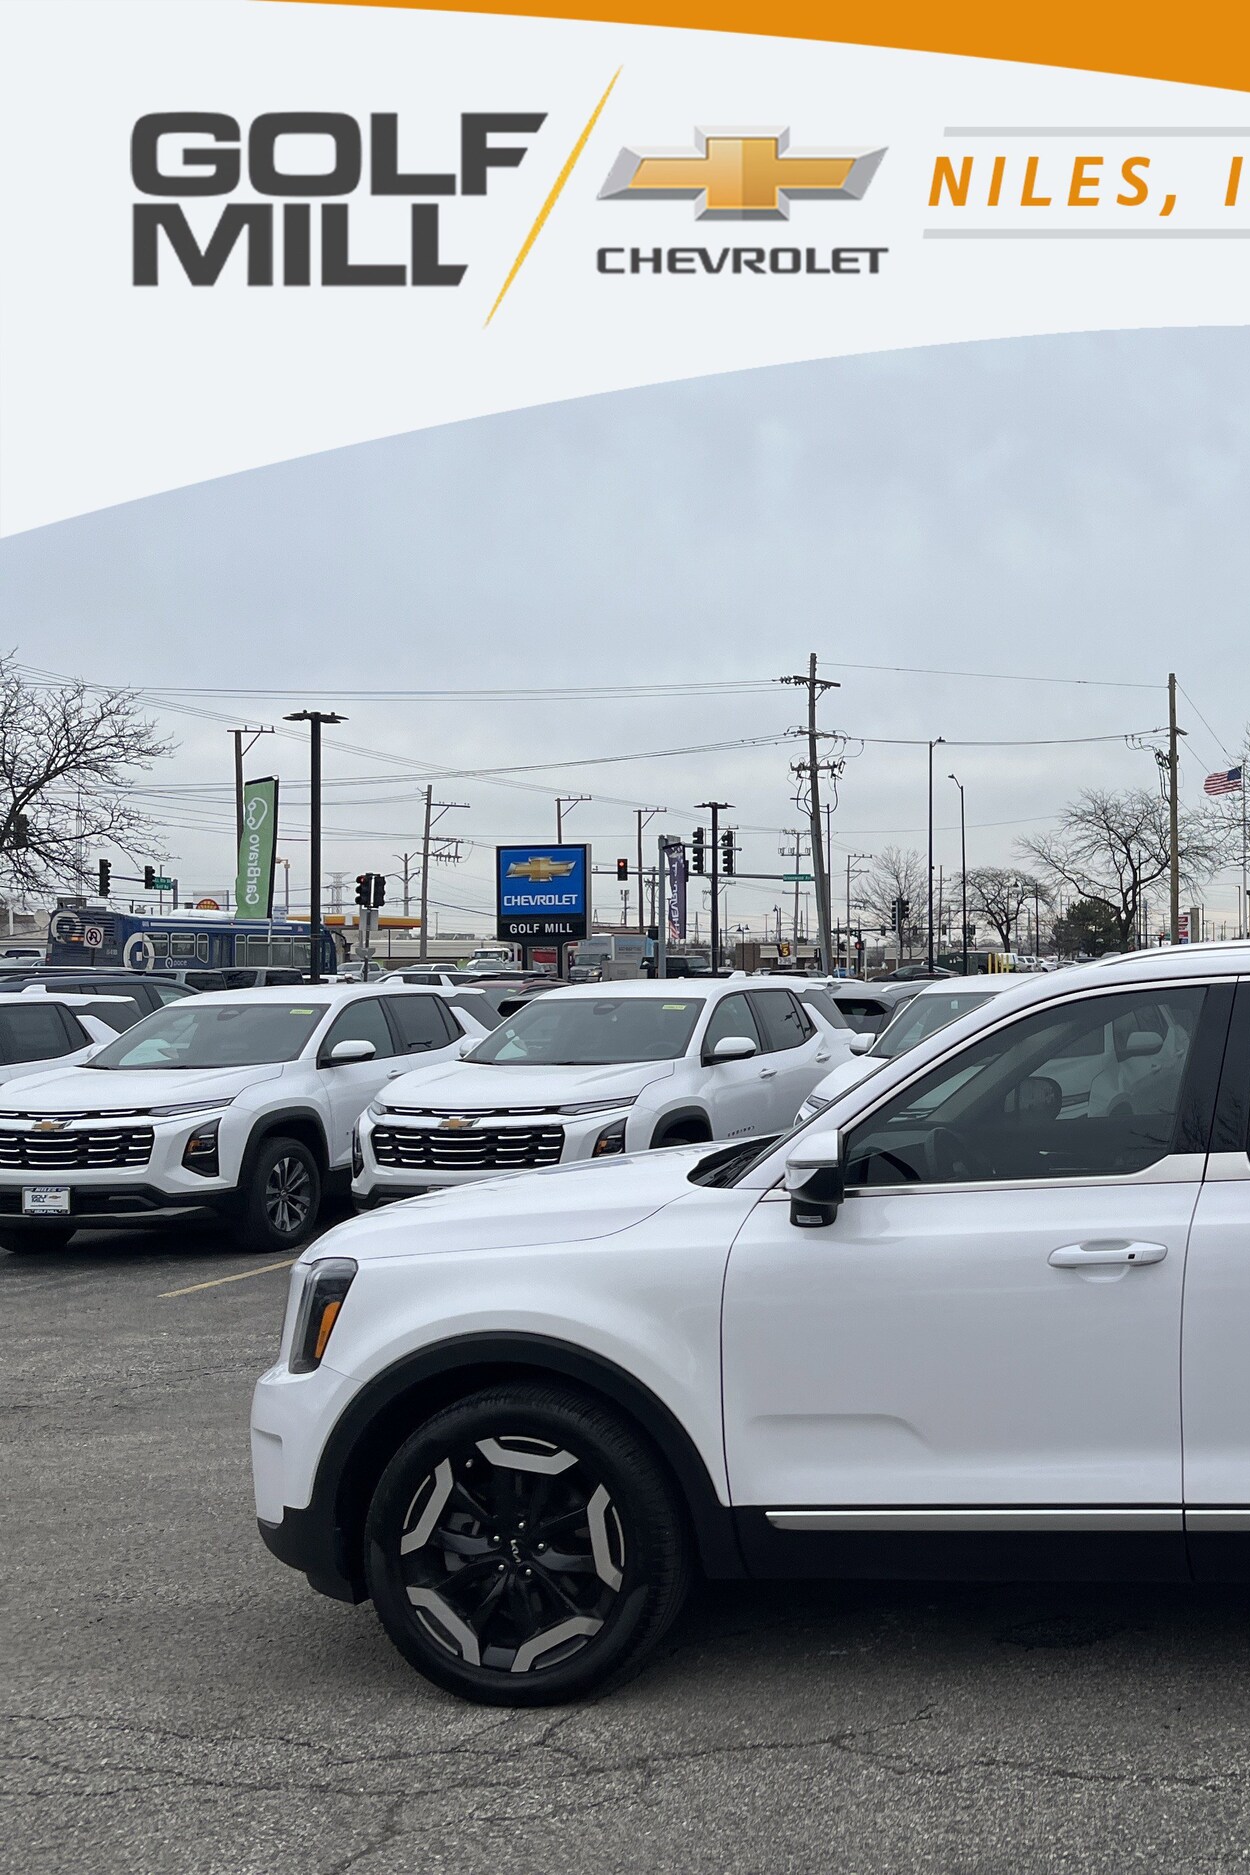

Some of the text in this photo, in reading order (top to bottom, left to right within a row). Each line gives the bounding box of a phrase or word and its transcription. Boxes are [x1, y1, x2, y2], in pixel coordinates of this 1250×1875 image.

[503, 894, 578, 906] CHEVROLET
[509, 922, 573, 934] GOLF MILL
